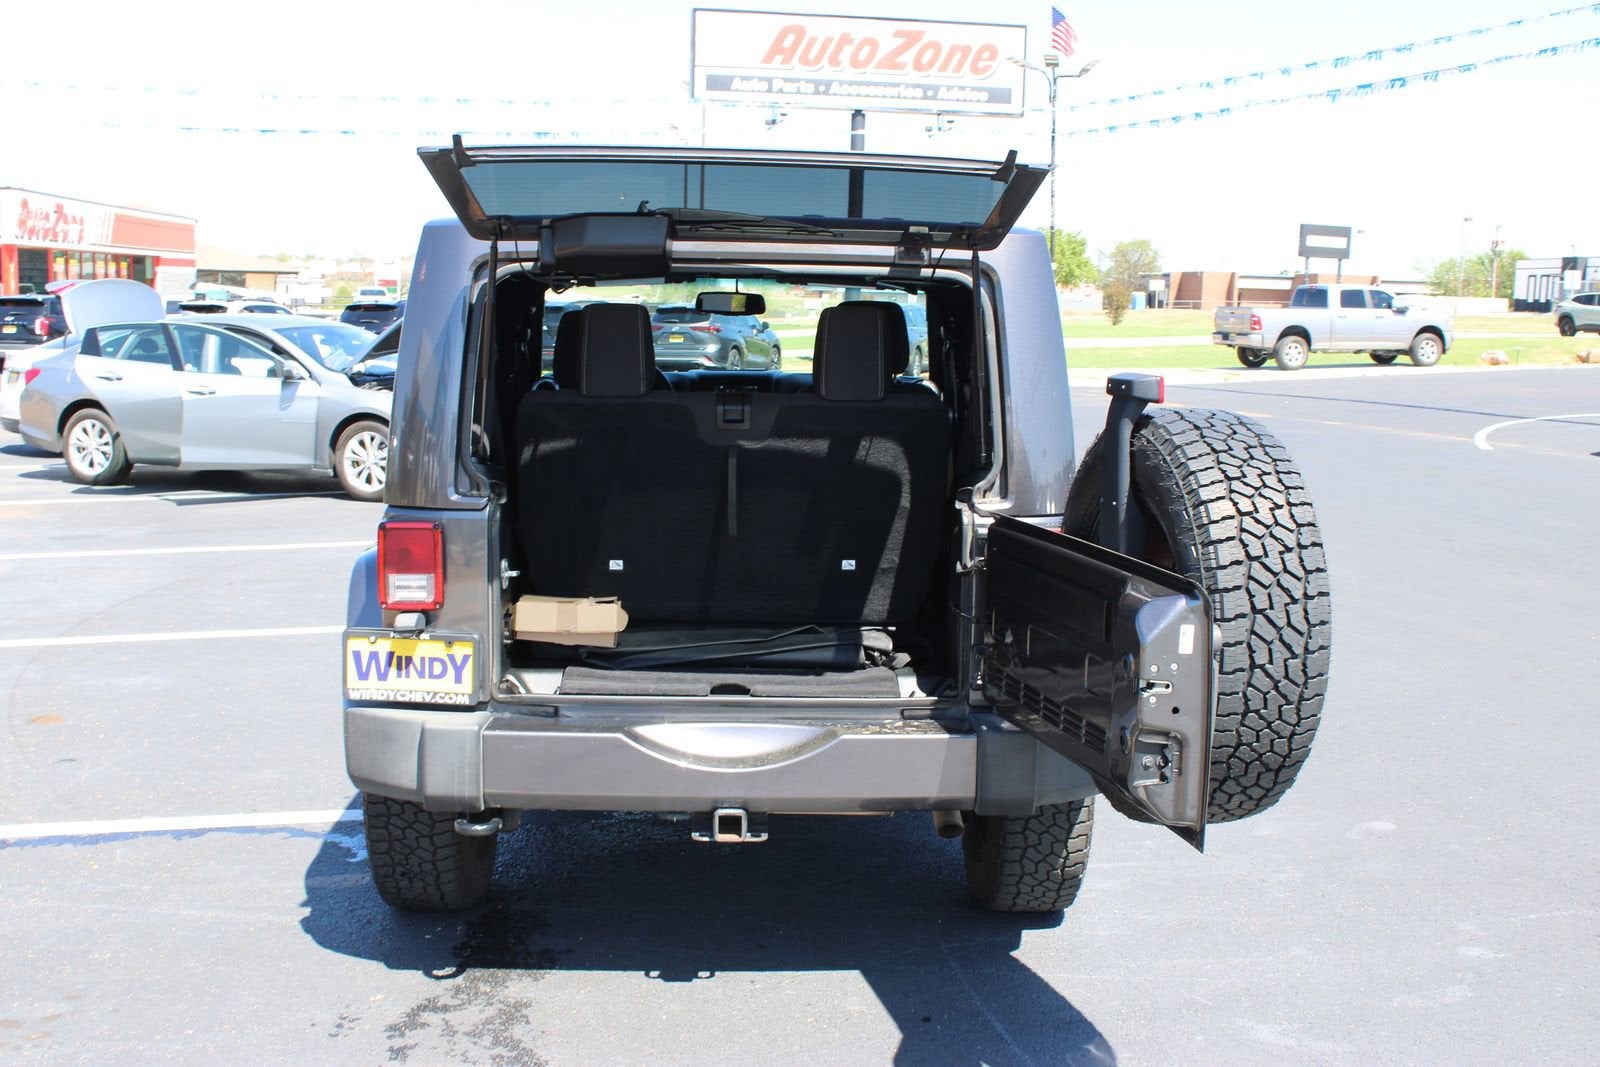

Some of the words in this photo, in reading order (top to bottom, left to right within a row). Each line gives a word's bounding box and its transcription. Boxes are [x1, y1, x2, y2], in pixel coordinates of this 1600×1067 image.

[761, 24, 998, 75] AutoZone
[772, 79, 815, 94] Parts
[352, 650, 473, 685] WINDY
[348, 689, 470, 705] WINDYCHEV.COM
